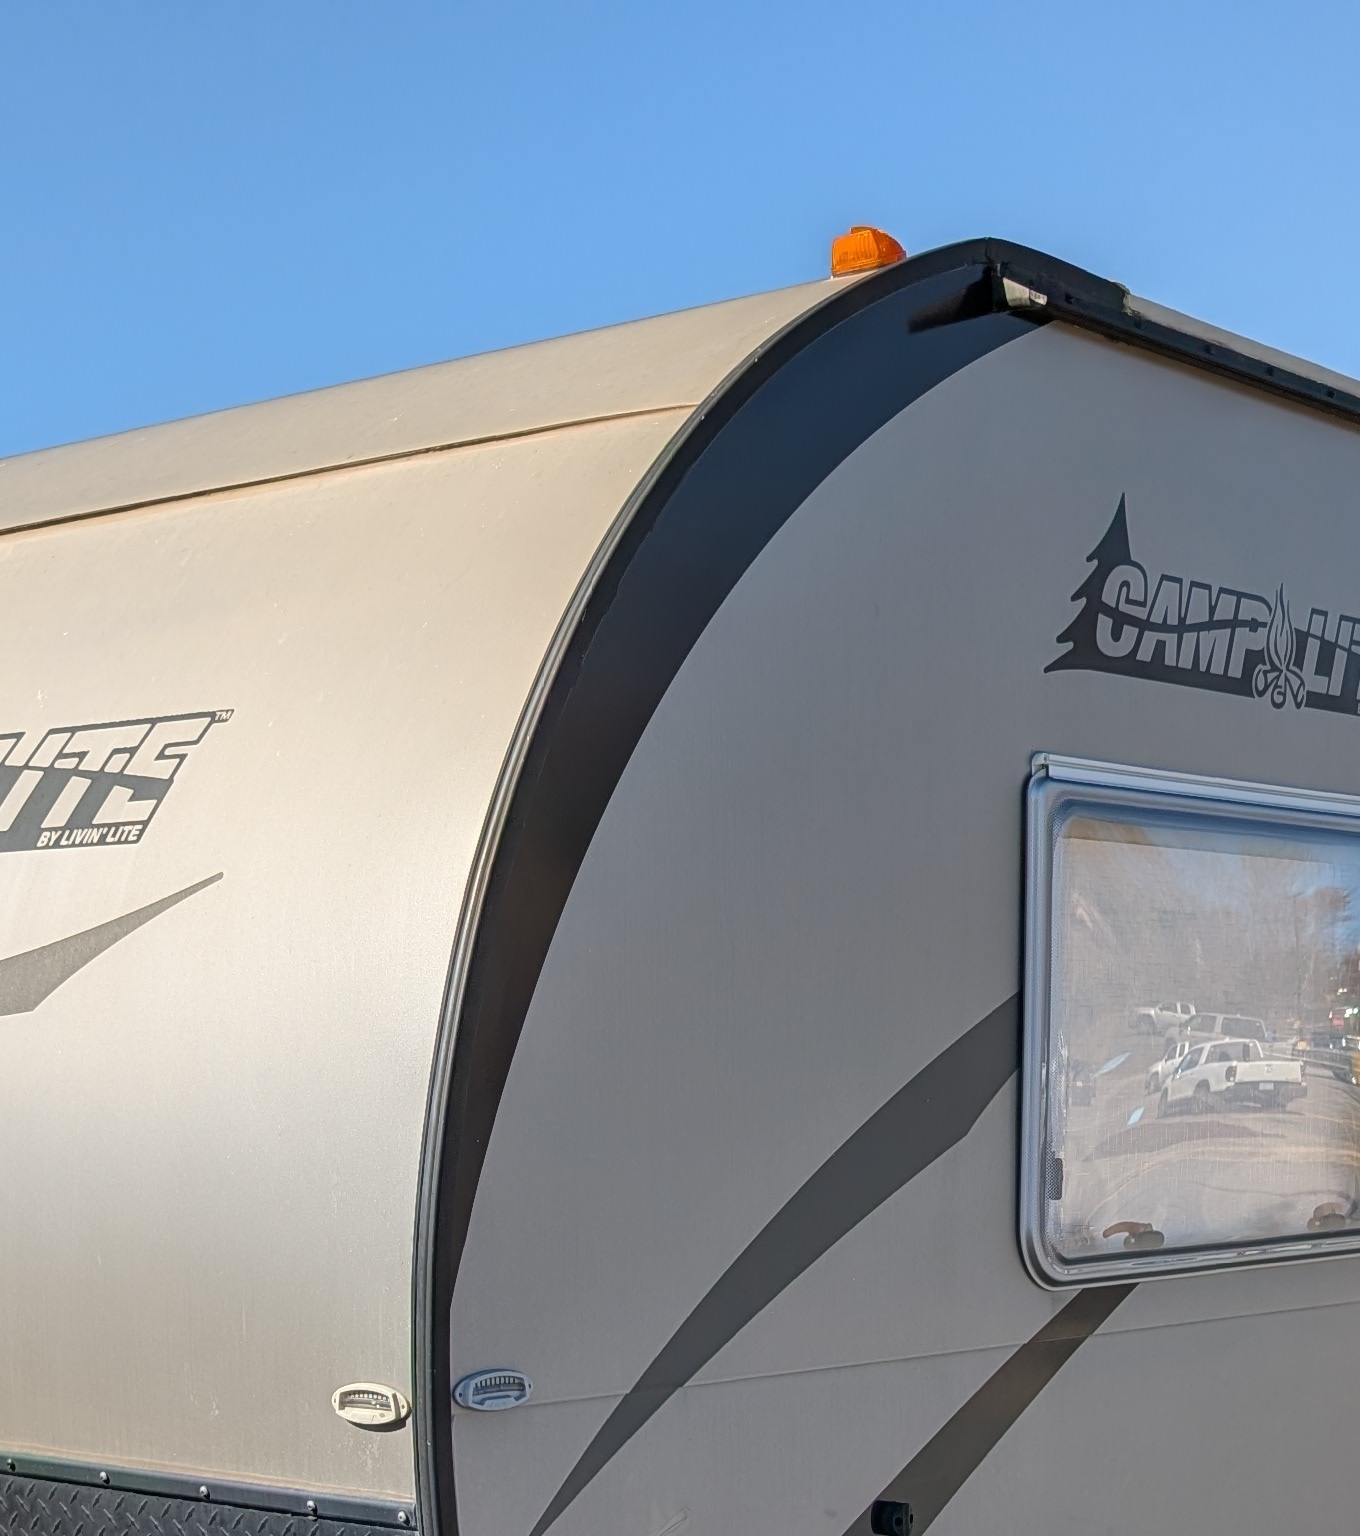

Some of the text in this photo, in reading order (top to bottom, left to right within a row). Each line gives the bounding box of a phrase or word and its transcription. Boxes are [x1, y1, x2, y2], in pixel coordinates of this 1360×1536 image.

[1095, 564, 1272, 679] CAMP
[36, 823, 144, 848] BY LIVIN' LITE
